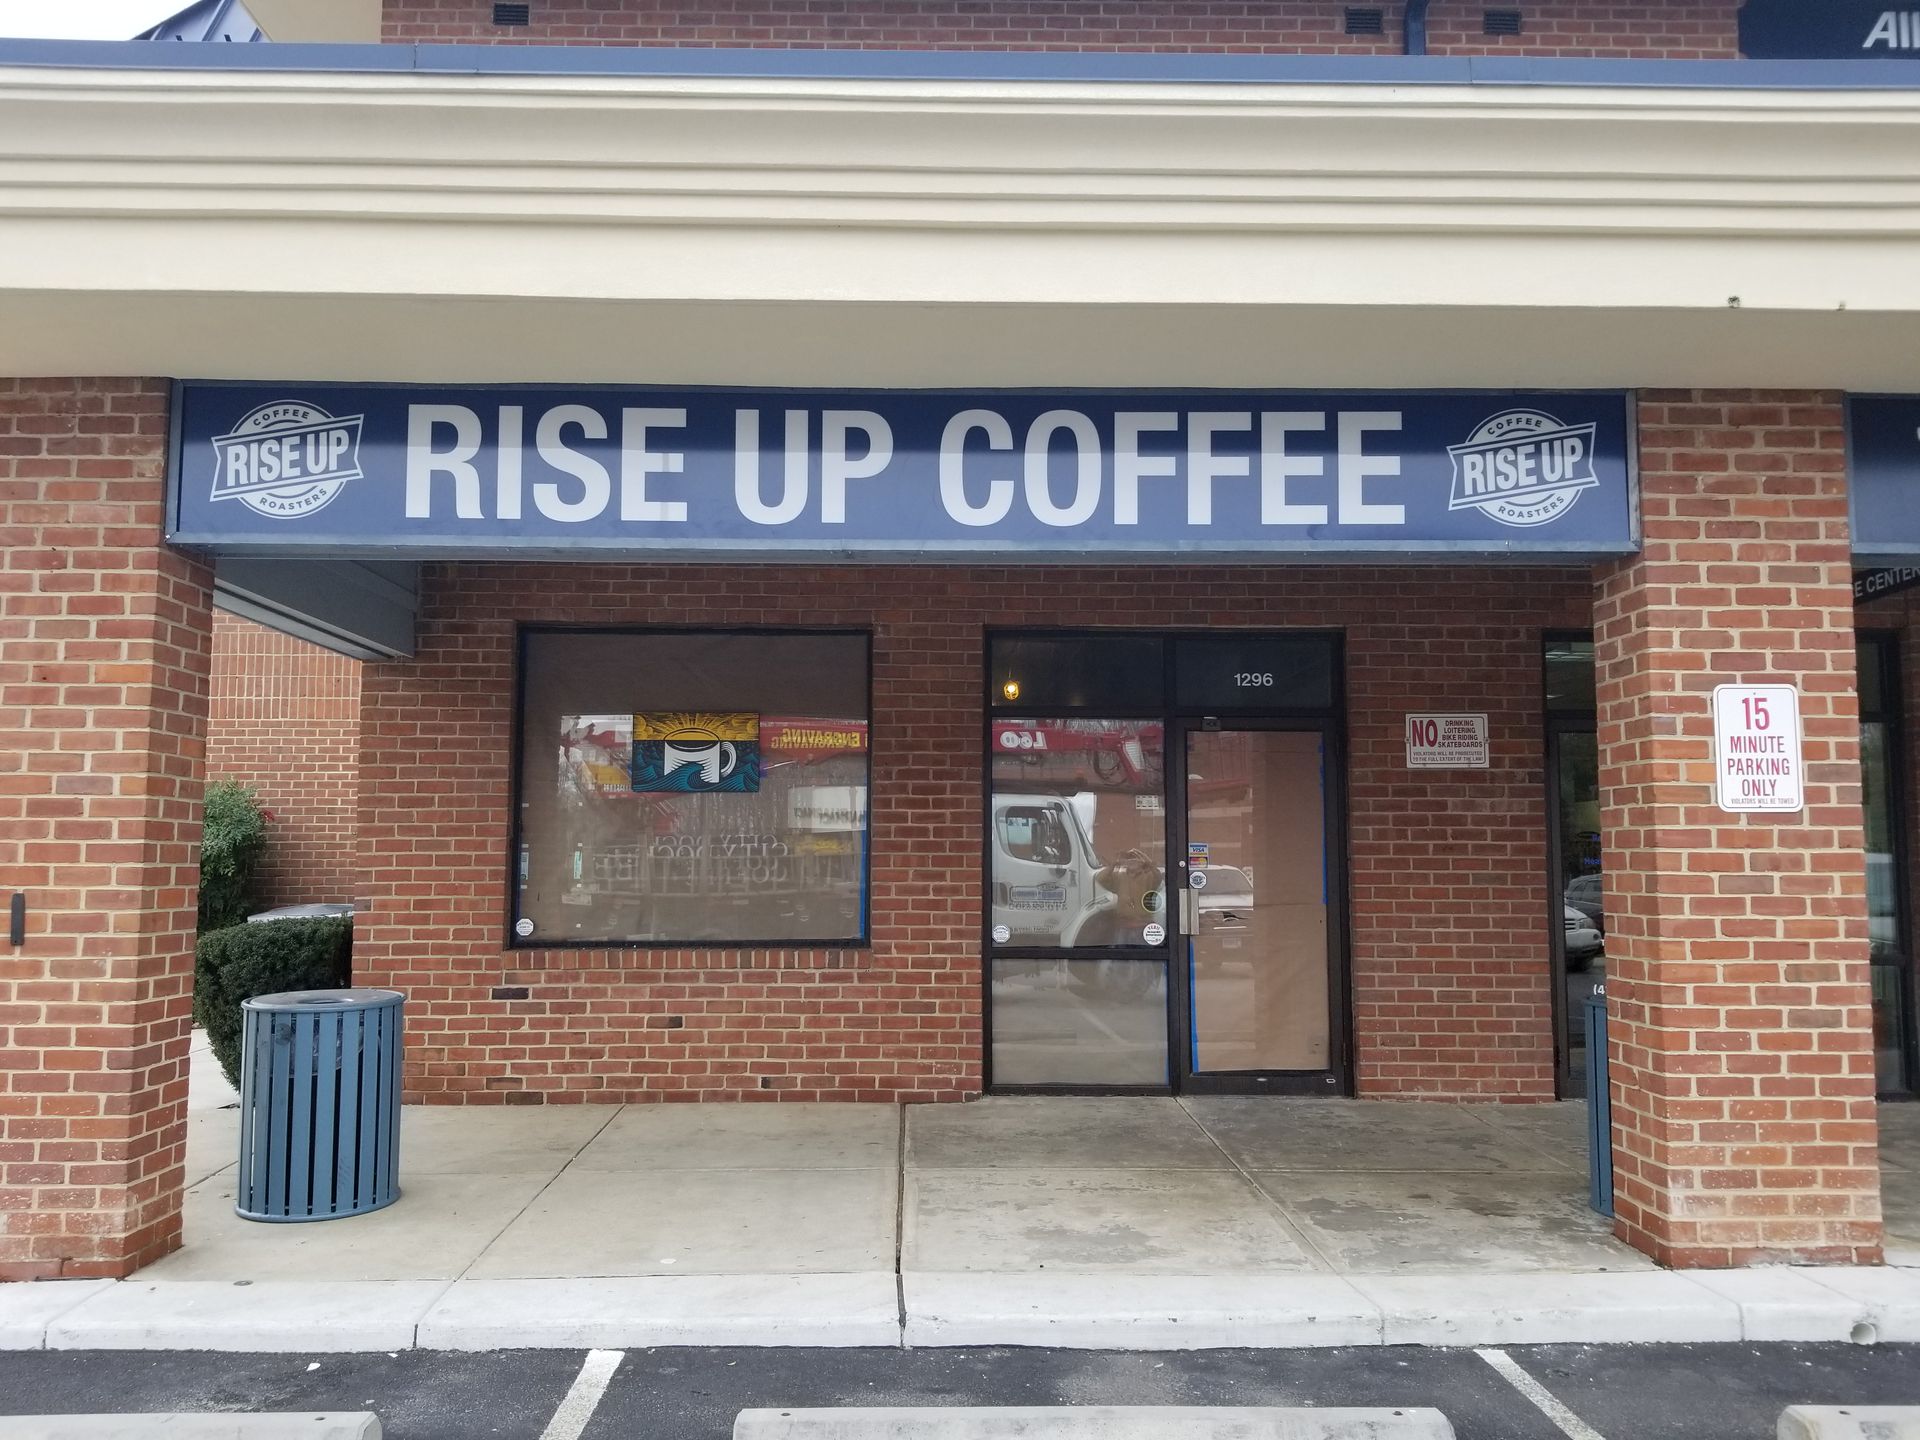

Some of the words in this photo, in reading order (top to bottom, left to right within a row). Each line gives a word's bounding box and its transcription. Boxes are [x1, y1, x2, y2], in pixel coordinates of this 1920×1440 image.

[253, 408, 310, 426] COFFEE
[1487, 417, 1543, 435] COFFEE
[226, 435, 301, 487] RISE
[306, 429, 349, 474] UP
[405, 404, 688, 522] RISE
[734, 409, 894, 525] UP
[939, 409, 1405, 526] COFFEE
[1463, 444, 1537, 496] RISE
[1541, 437, 1584, 482] UP
[259, 488, 328, 510] ROASTERS
[1498, 495, 1565, 518] ROASTERS
[1234, 672, 1274, 687] 1296
[1742, 697, 1770, 731] 15
[1412, 719, 1438, 748] NO
[1730, 736, 1785, 753] MINUTE
[1727, 758, 1790, 775] PARKING
[1741, 778, 1777, 797] ONLY
